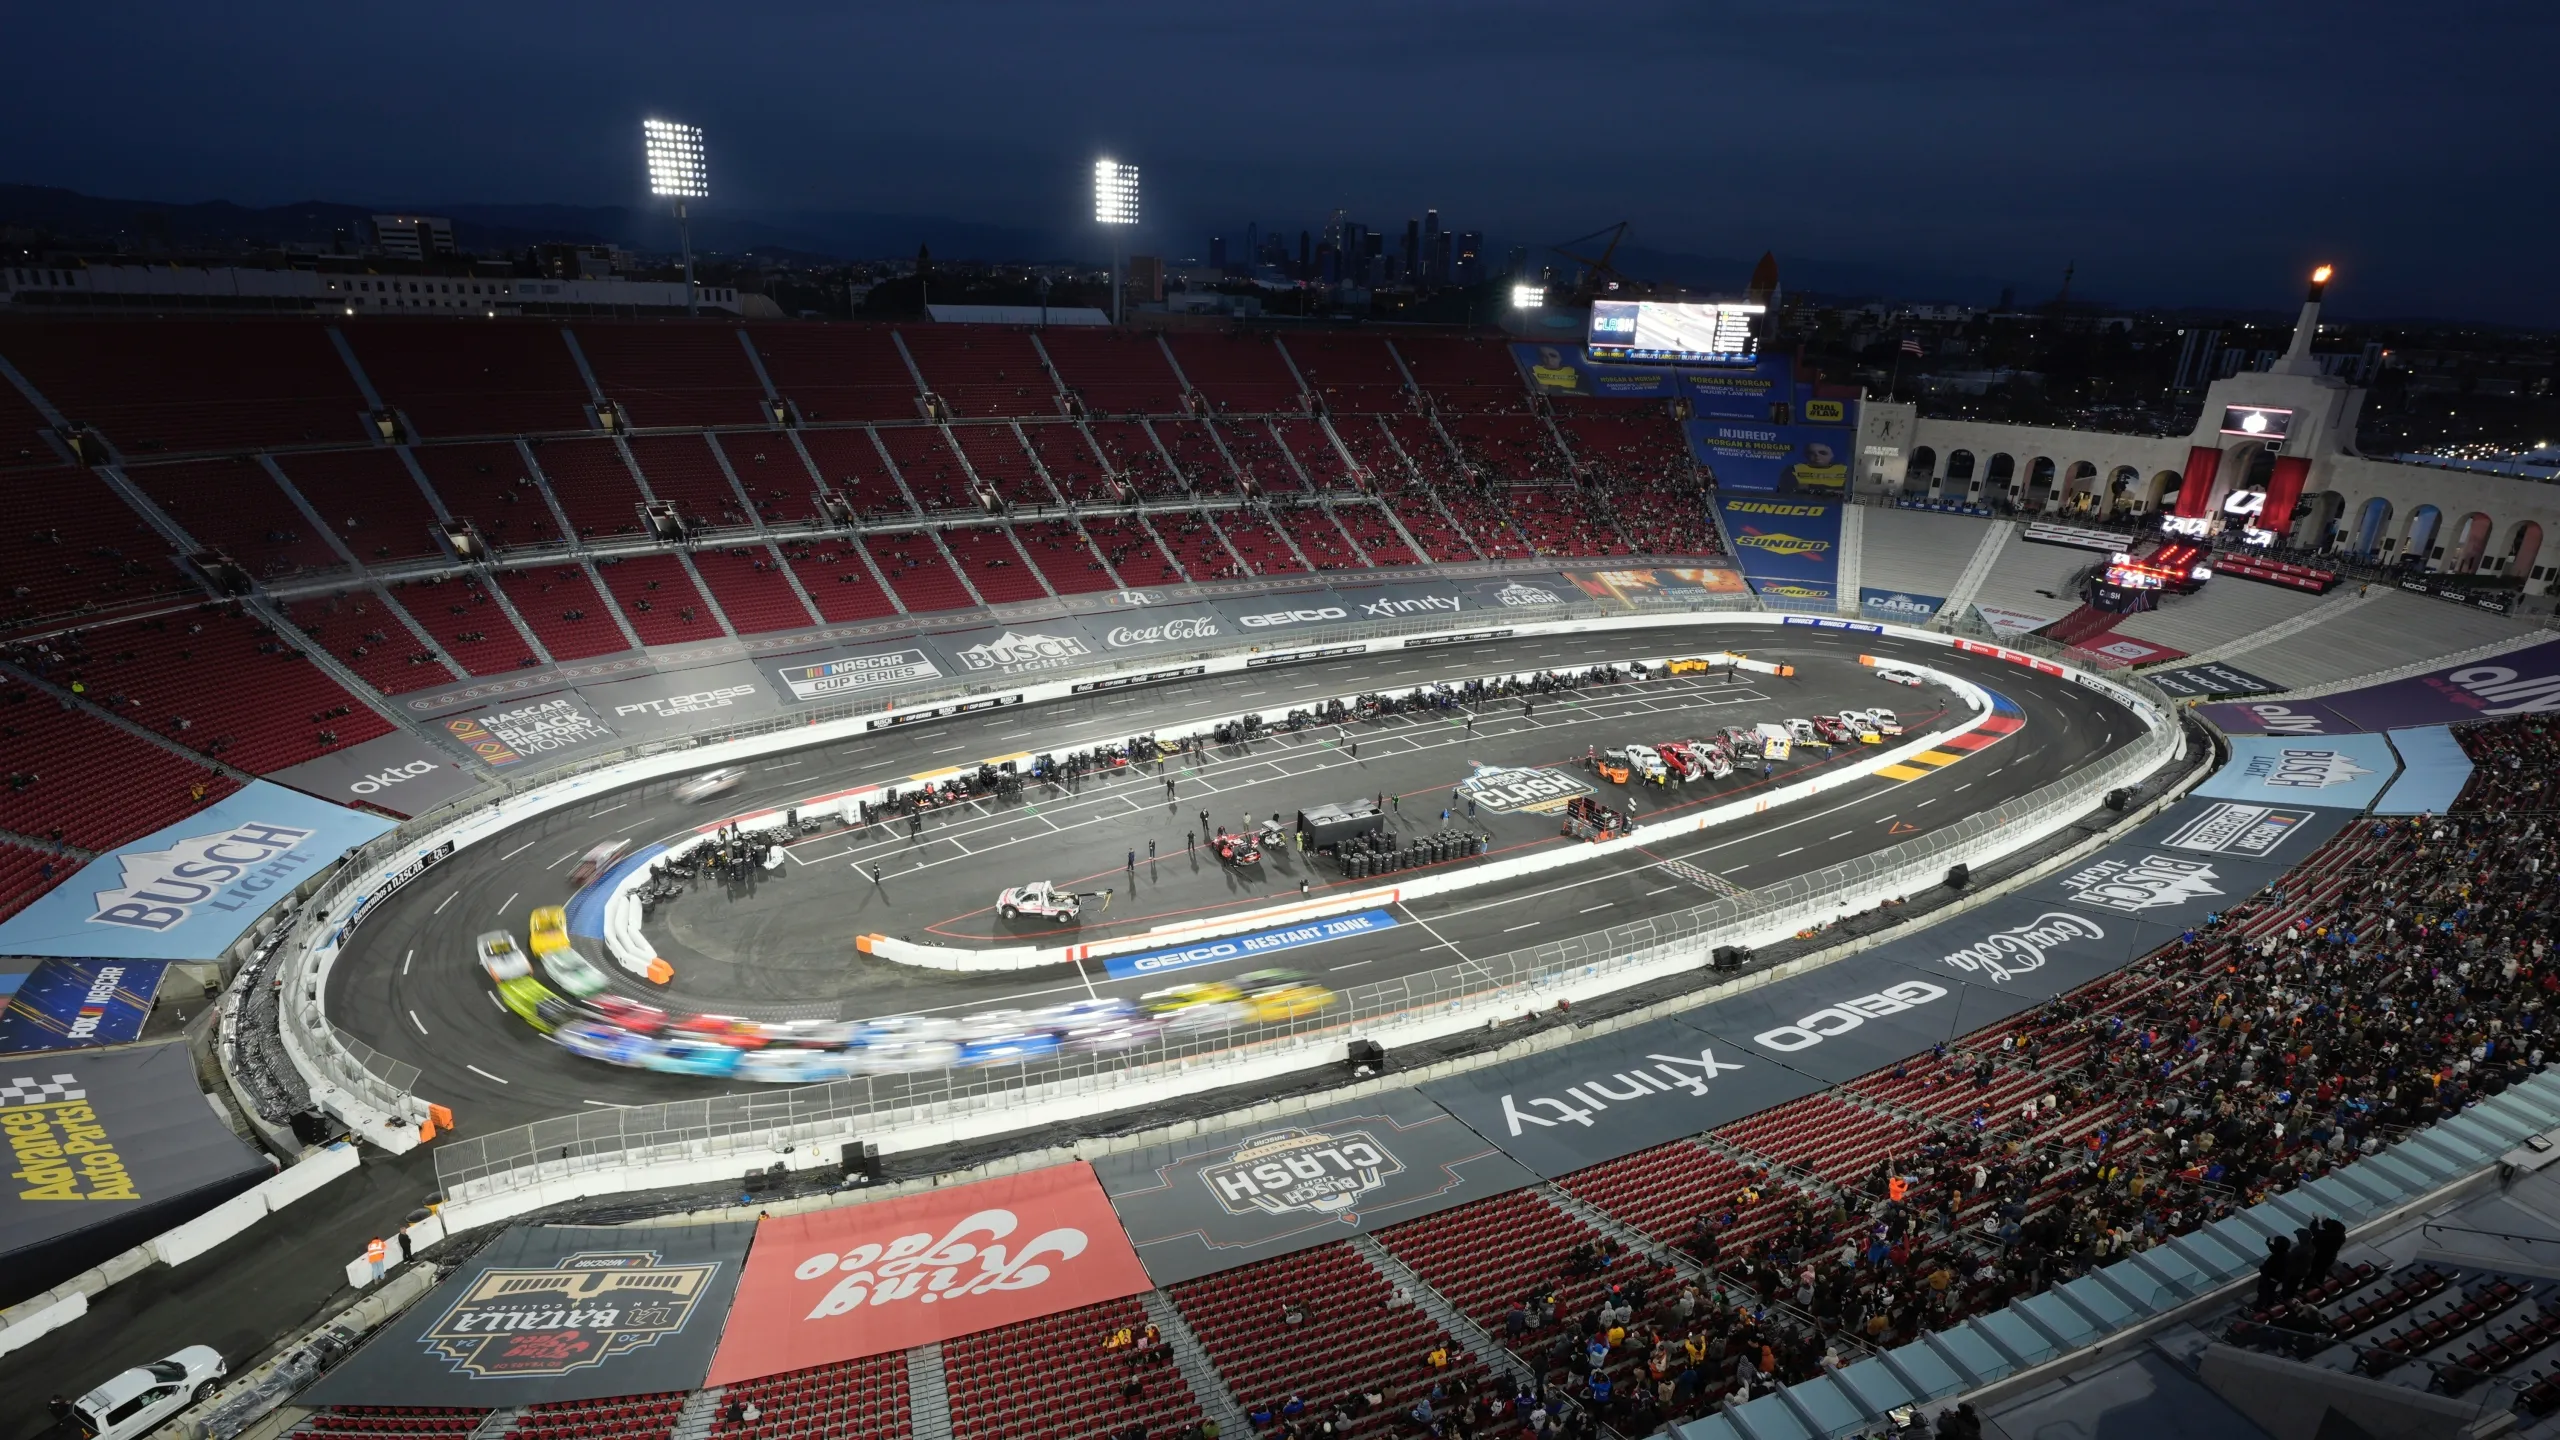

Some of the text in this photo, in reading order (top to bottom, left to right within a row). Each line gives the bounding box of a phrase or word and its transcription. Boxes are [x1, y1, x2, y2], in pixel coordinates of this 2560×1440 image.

[1594, 317, 1634, 333] CLASH
[1690, 376, 1725, 385] MORGAN
[1719, 428, 1776, 441] INJURED?
[1707, 439, 1743, 447] MORGAN
[1754, 443, 1790, 451] MORGAN
[1726, 501, 1825, 516] SUNOCO
[1740, 536, 1824, 551] SUNOCO
[1764, 587, 1826, 596] SUNOCO
[2099, 589, 2121, 600] CSH
[2402, 581, 2427, 591] NOCO
[2440, 590, 2465, 601] NOCO
[1359, 595, 1461, 618] xfinity
[1502, 594, 1559, 605] CLASH
[1867, 597, 1931, 614] CABO
[2478, 600, 2504, 610] NOCO
[1239, 607, 1347, 627] GEICO
[1787, 617, 1815, 625] SUNOCO
[1819, 620, 1847, 628] SUNOCO
[1849, 622, 1877, 632] SUNOCO
[1107, 616, 1218, 647] Coca-Cola
[961, 636, 1090, 670] BUSCH
[1971, 644, 1988, 653] TOYOTA
[2006, 653, 2023, 662] TOYOTA
[831, 654, 904, 675] NASCAR
[1001, 657, 1074, 675] LIGHT
[2039, 664, 2053, 672] TOYOTA
[814, 667, 916, 691] CUP SERIES
[2150, 675, 2196, 693] NOCO
[2175, 670, 2230, 692] NOCO
[2200, 665, 2267, 690] NOCO
[614, 683, 755, 717] PIT BOSS
[658, 698, 733, 717] GRILLS
[1000, 695, 1016, 704] BUSCH
[2110, 690, 2131, 707] NOCO
[478, 699, 570, 727] NASCAR
[488, 705, 579, 732] CELEBRATES
[916, 711, 932, 719] SERIES
[939, 705, 956, 714] BUSCH
[2252, 705, 2324, 733] ally
[494, 711, 589, 741] BLACK
[874, 717, 892, 726] BUSCH
[505, 719, 594, 747] HISTORY
[514, 725, 609, 757] MONTH
[350, 759, 440, 794] okta
[2243, 755, 2276, 778] LIGHT
[2264, 749, 2334, 789] BUSCH
[1480, 771, 1528, 786] BUSCH
[1472, 774, 1581, 807] CLASH
[2192, 811, 2253, 845] CUP SERIES
[2235, 822, 2288, 850] NASCAR
[92, 822, 310, 931] BUSCH
[209, 853, 305, 912] LIGHT
[2060, 860, 2128, 891] LIGHT
[2068, 855, 2213, 912] BUSCH
[353, 887, 387, 924] Bienvenidos
[391, 860, 424, 888] NASCAR
[1134, 917, 1373, 970] GEICO RESTART ZONE
[1945, 912, 2105, 984] Coca-Cola
[67, 966, 126, 1039] FOX NASCAR
[1753, 980, 1948, 1052] GEICO
[1500, 1048, 1746, 1137] xfinity
[1243, 1137, 1318, 1158] LOS ANGELES
[1253, 1134, 1286, 1147] NASCAR
[1300, 1144, 1321, 1154] THE
[0, 1111, 85, 1200] Advance
[1234, 1150, 1295, 1170] COLISEUM
[1216, 1143, 1383, 1201] CLASH
[1296, 1175, 1334, 1189] LIGHT
[1282, 1176, 1358, 1205] BUSCH
[795, 1208, 1018, 1280] Taco
[575, 1259, 627, 1268] NASCAR
[803, 1227, 1088, 1322] King
[487, 1303, 562, 1311] COLISEO
[453, 1306, 671, 1332] LA BATALLA
[456, 1333, 640, 1347] 20 24
[502, 1340, 591, 1359] King
